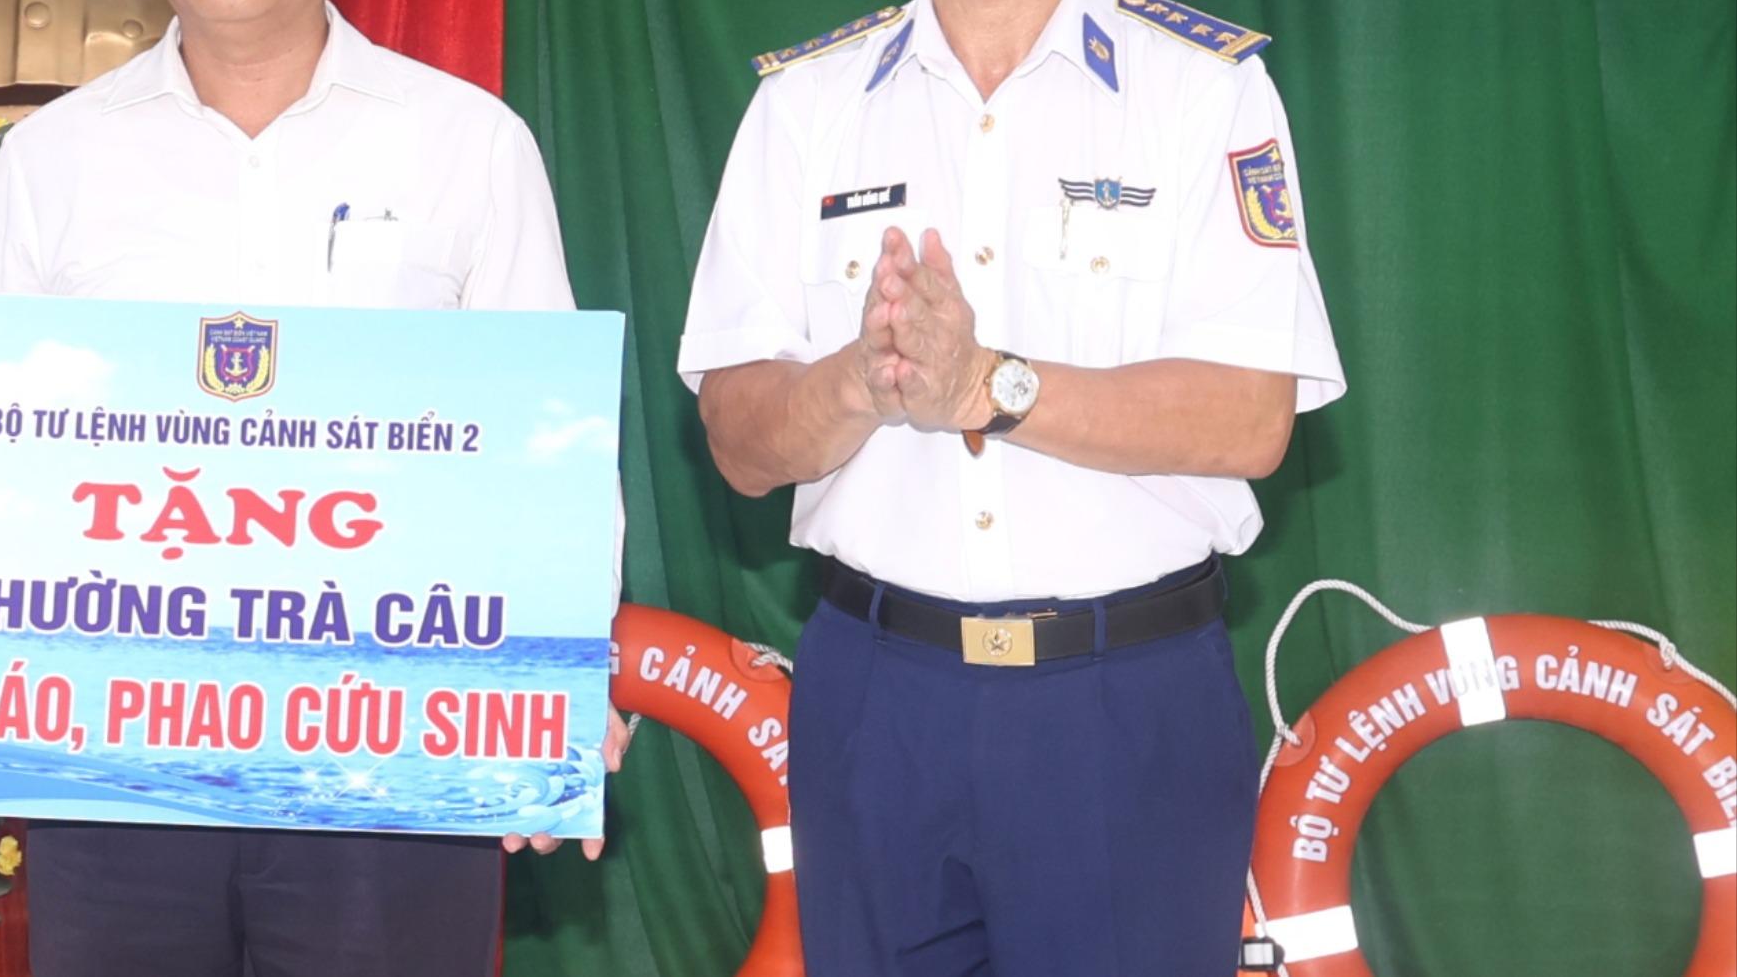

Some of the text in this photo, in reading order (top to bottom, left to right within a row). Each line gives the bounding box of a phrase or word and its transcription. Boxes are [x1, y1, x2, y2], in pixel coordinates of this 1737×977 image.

[33, 408, 69, 438] TƯ
[75, 407, 145, 447] LỆNH
[157, 409, 229, 445] VÙNG
[241, 410, 316, 447] CẢNH
[327, 415, 378, 449] SÁT
[388, 411, 452, 451] BIỂN
[462, 424, 478, 452] 2
[73, 467, 384, 561] TẶNG
[231, 581, 350, 641] TRÀ
[375, 584, 503, 646] CÂU
[639, 645, 748, 721] CẢNH
[1535, 646, 1638, 707] CẢNH
[107, 679, 264, 750] PHAO
[285, 674, 404, 756] CỨU
[423, 690, 567, 760] SINH
[1334, 683, 1427, 763] LỆNH
[1646, 692, 1716, 756] SÁT
[1305, 754, 1351, 804] TƯ
[1289, 813, 1340, 863] BỘ
